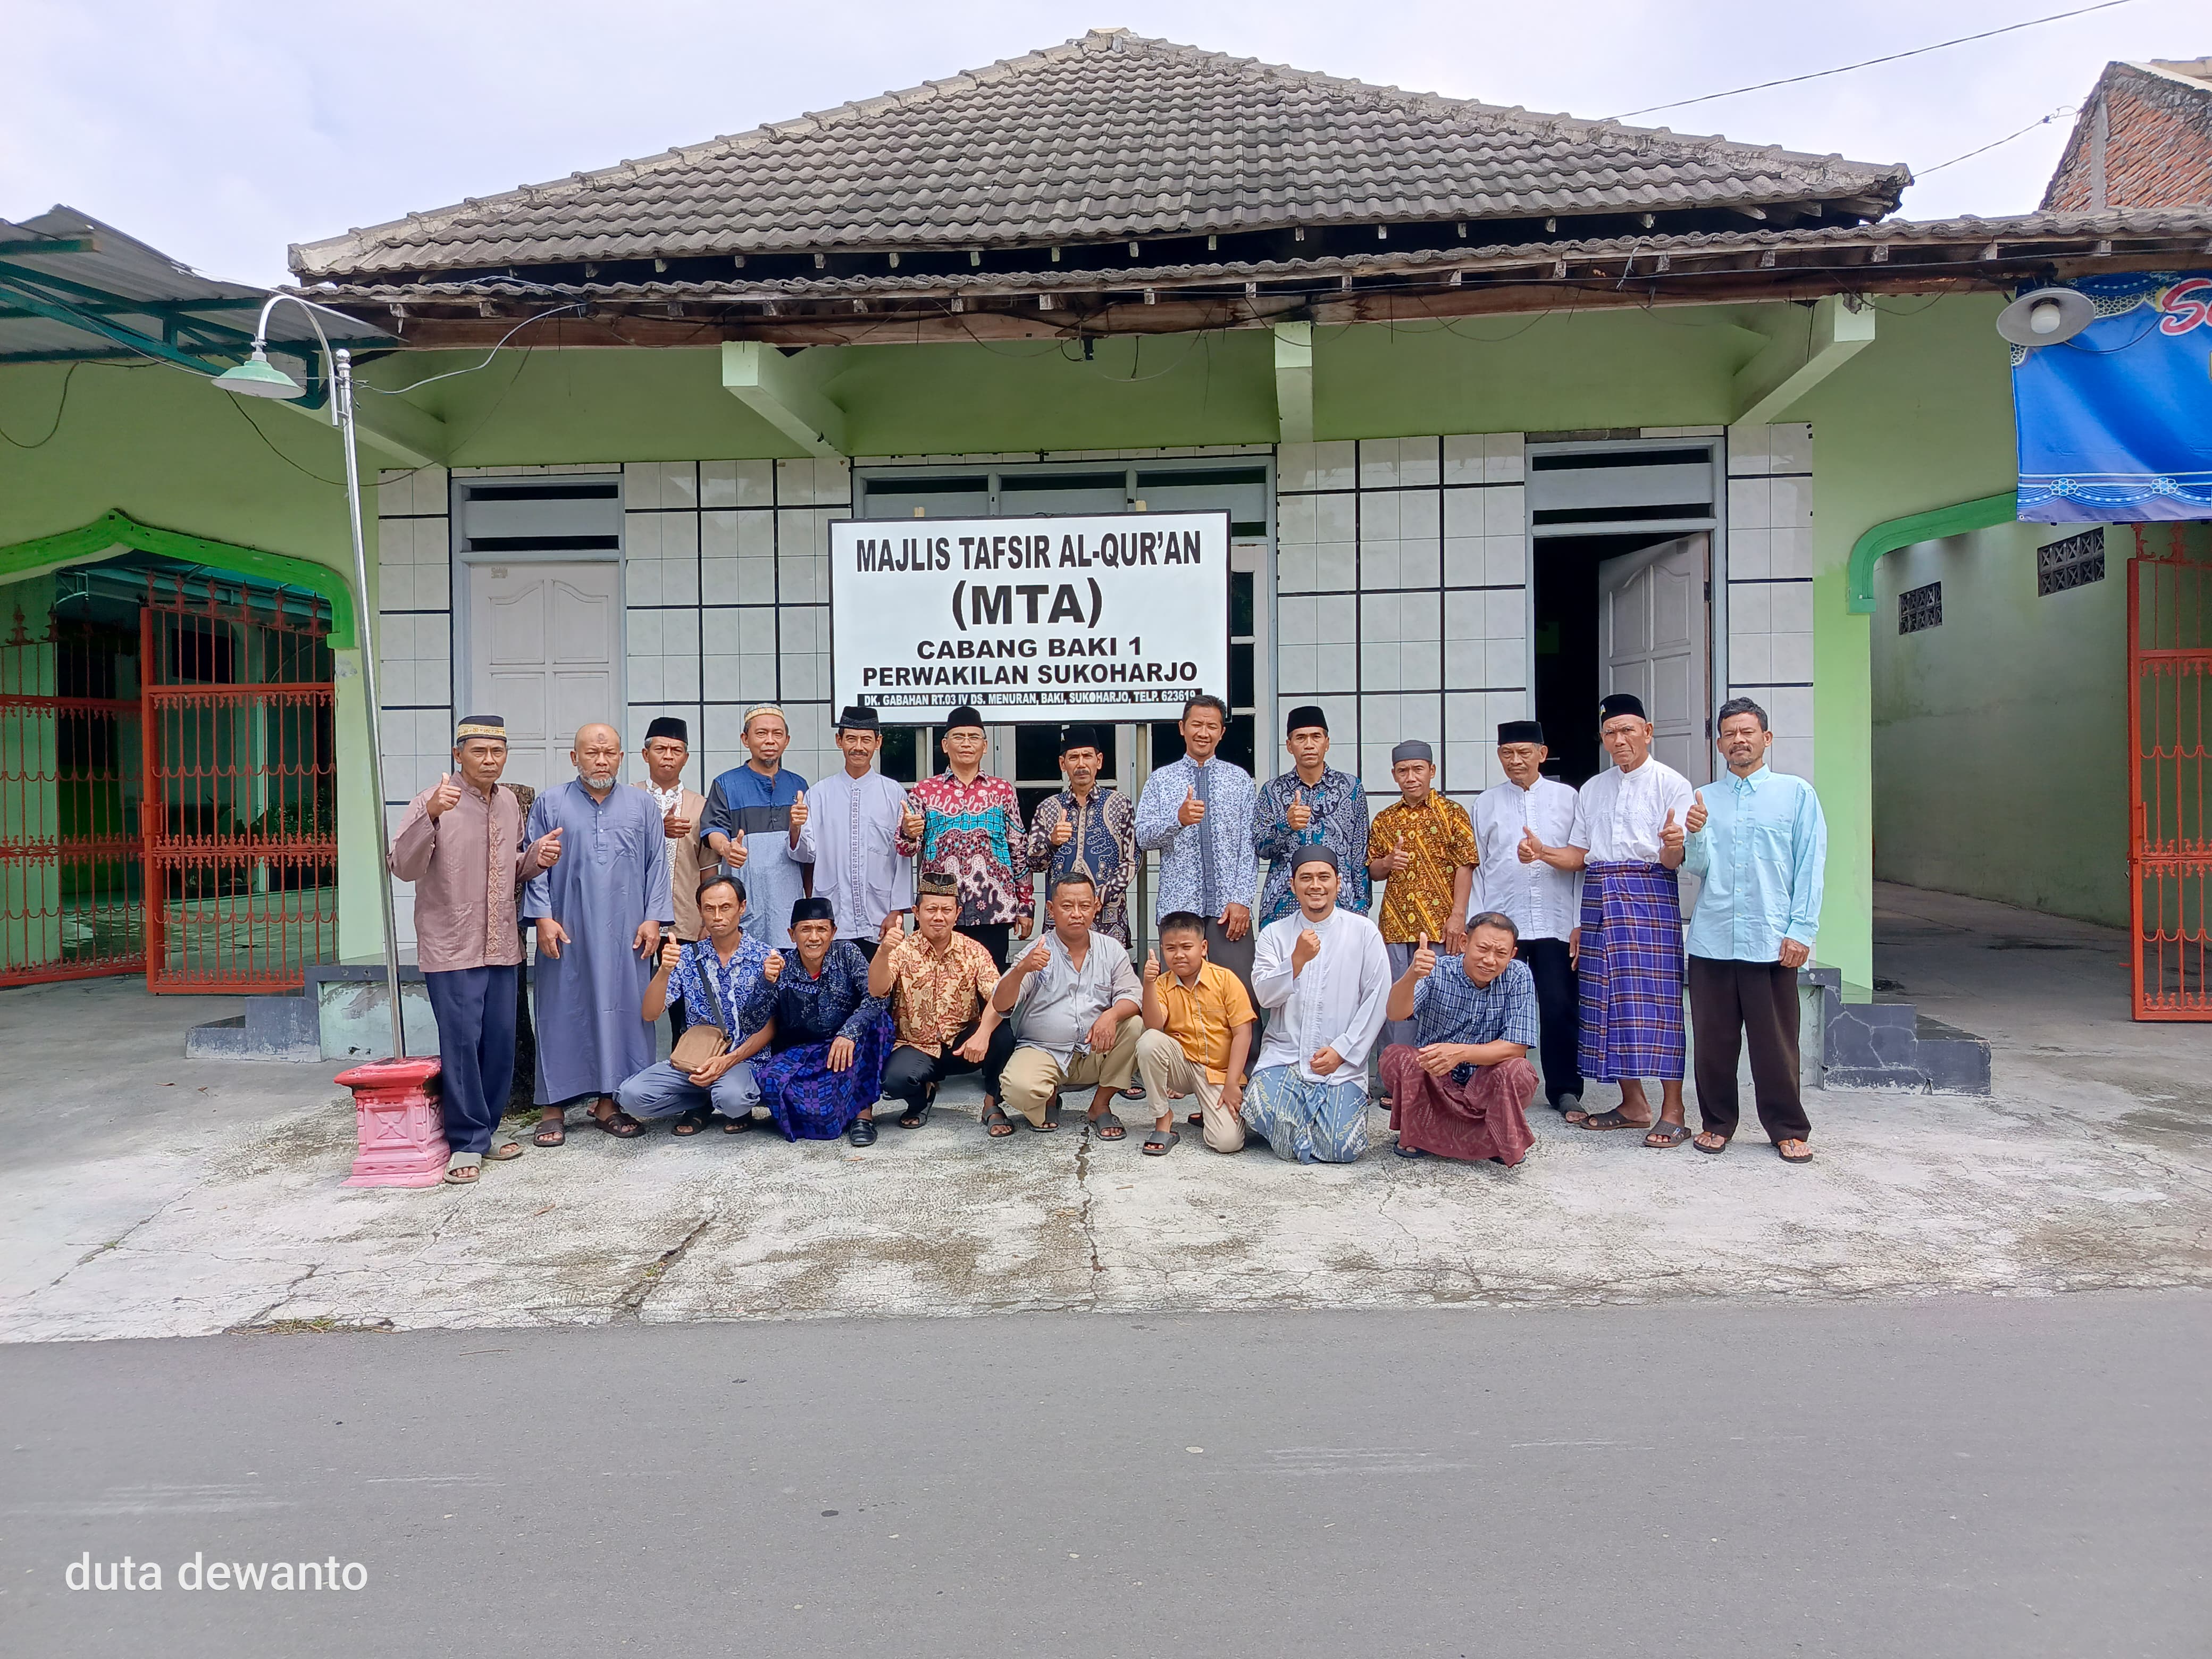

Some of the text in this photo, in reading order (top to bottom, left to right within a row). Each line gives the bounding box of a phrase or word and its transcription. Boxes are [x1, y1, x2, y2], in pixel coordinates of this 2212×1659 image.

[2159, 277, 2212, 336] S
[857, 537, 951, 572] MAJLIS
[959, 535, 1051, 570] TAFSIR
[952, 577, 1102, 631] (MTA)
[917, 636, 1141, 660] CABANG BAKI 1
[863, 661, 1197, 686] PERWAKILAN SUKOHARJO
[864, 695, 880, 706] DK.
[883, 694, 929, 706] GABAHAN
[931, 694, 956, 706] RT.03
[970, 693, 986, 705] DS.
[988, 693, 1039, 706] MENURAN,
[1041, 692, 1067, 705] BAKI,
[1069, 691, 1132, 705] SUKOHARJO,
[1133, 691, 1159, 702] TELP.
